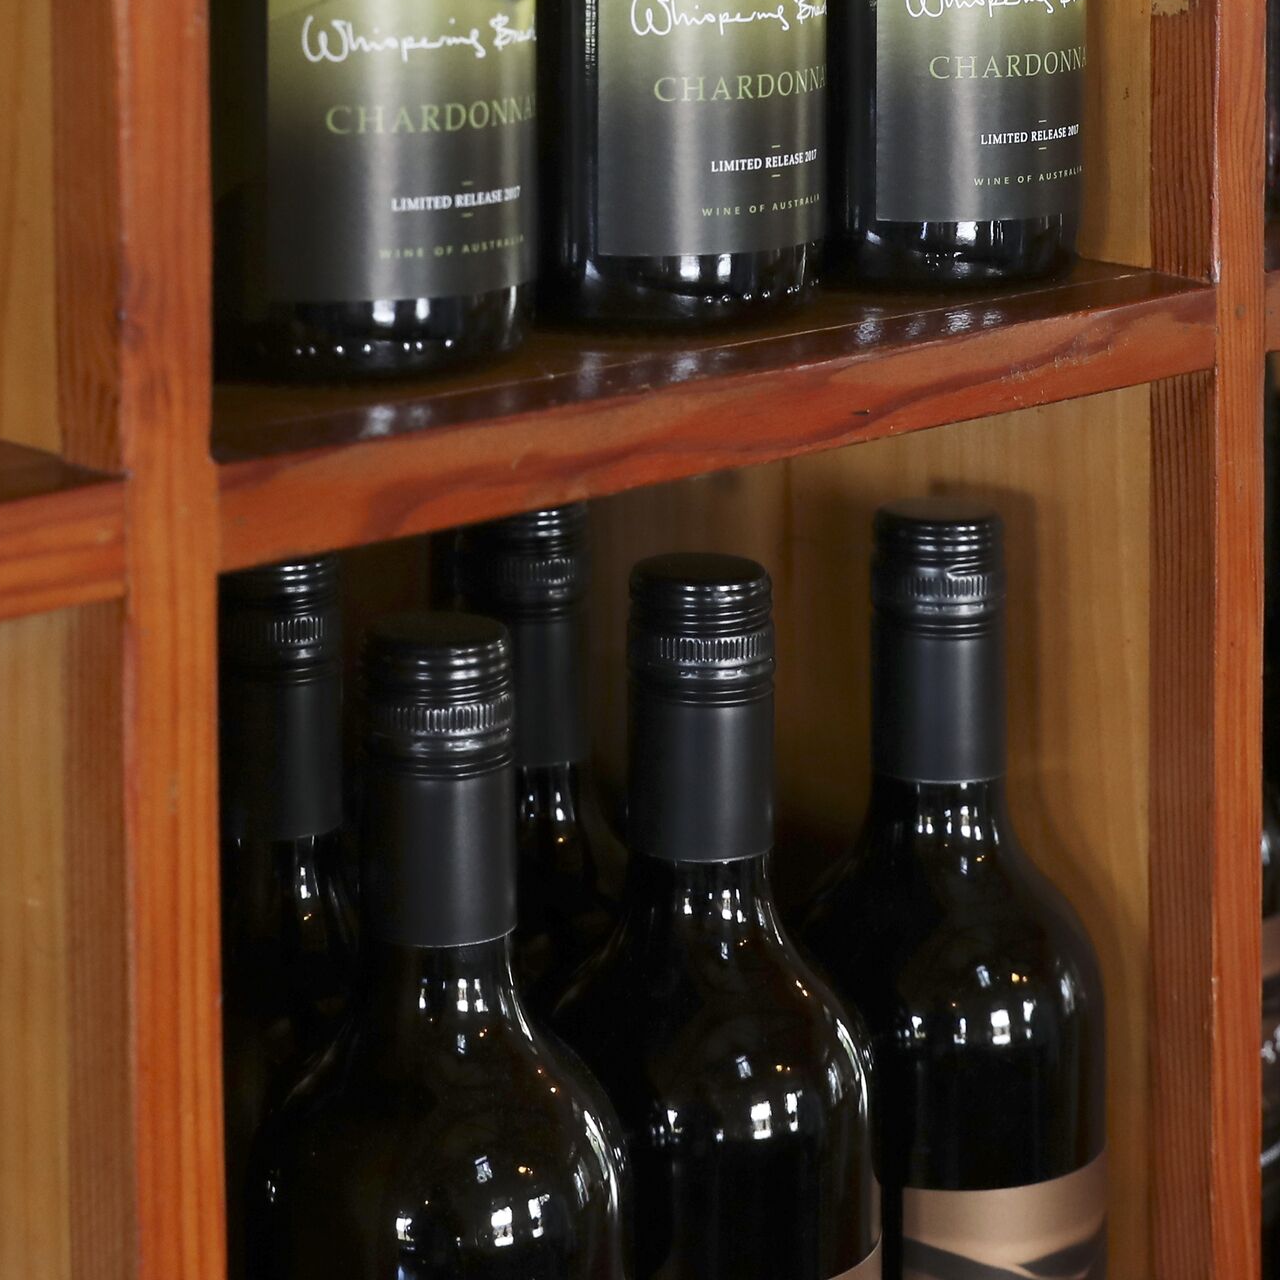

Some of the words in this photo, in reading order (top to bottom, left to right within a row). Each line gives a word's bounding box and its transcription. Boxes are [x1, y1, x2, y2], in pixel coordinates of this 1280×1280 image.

[302, 15, 487, 62] Whispering
[980, 132, 1028, 145] LIMITED
[1031, 126, 1067, 142] RELEASE
[711, 157, 762, 173] LIMITED
[765, 151, 804, 168] RELEASE
[805, 149, 817, 162] 2017
[974, 177, 1009, 186] WINE
[1017, 175, 1032, 183] OF
[1039, 165, 1082, 181] AUSTRALIA
[391, 195, 452, 211] LIMITED
[455, 189, 502, 208] RELEASE
[702, 206, 741, 217] WINE
[749, 204, 765, 214] OF
[772, 193, 820, 211] AUSTRALIA
